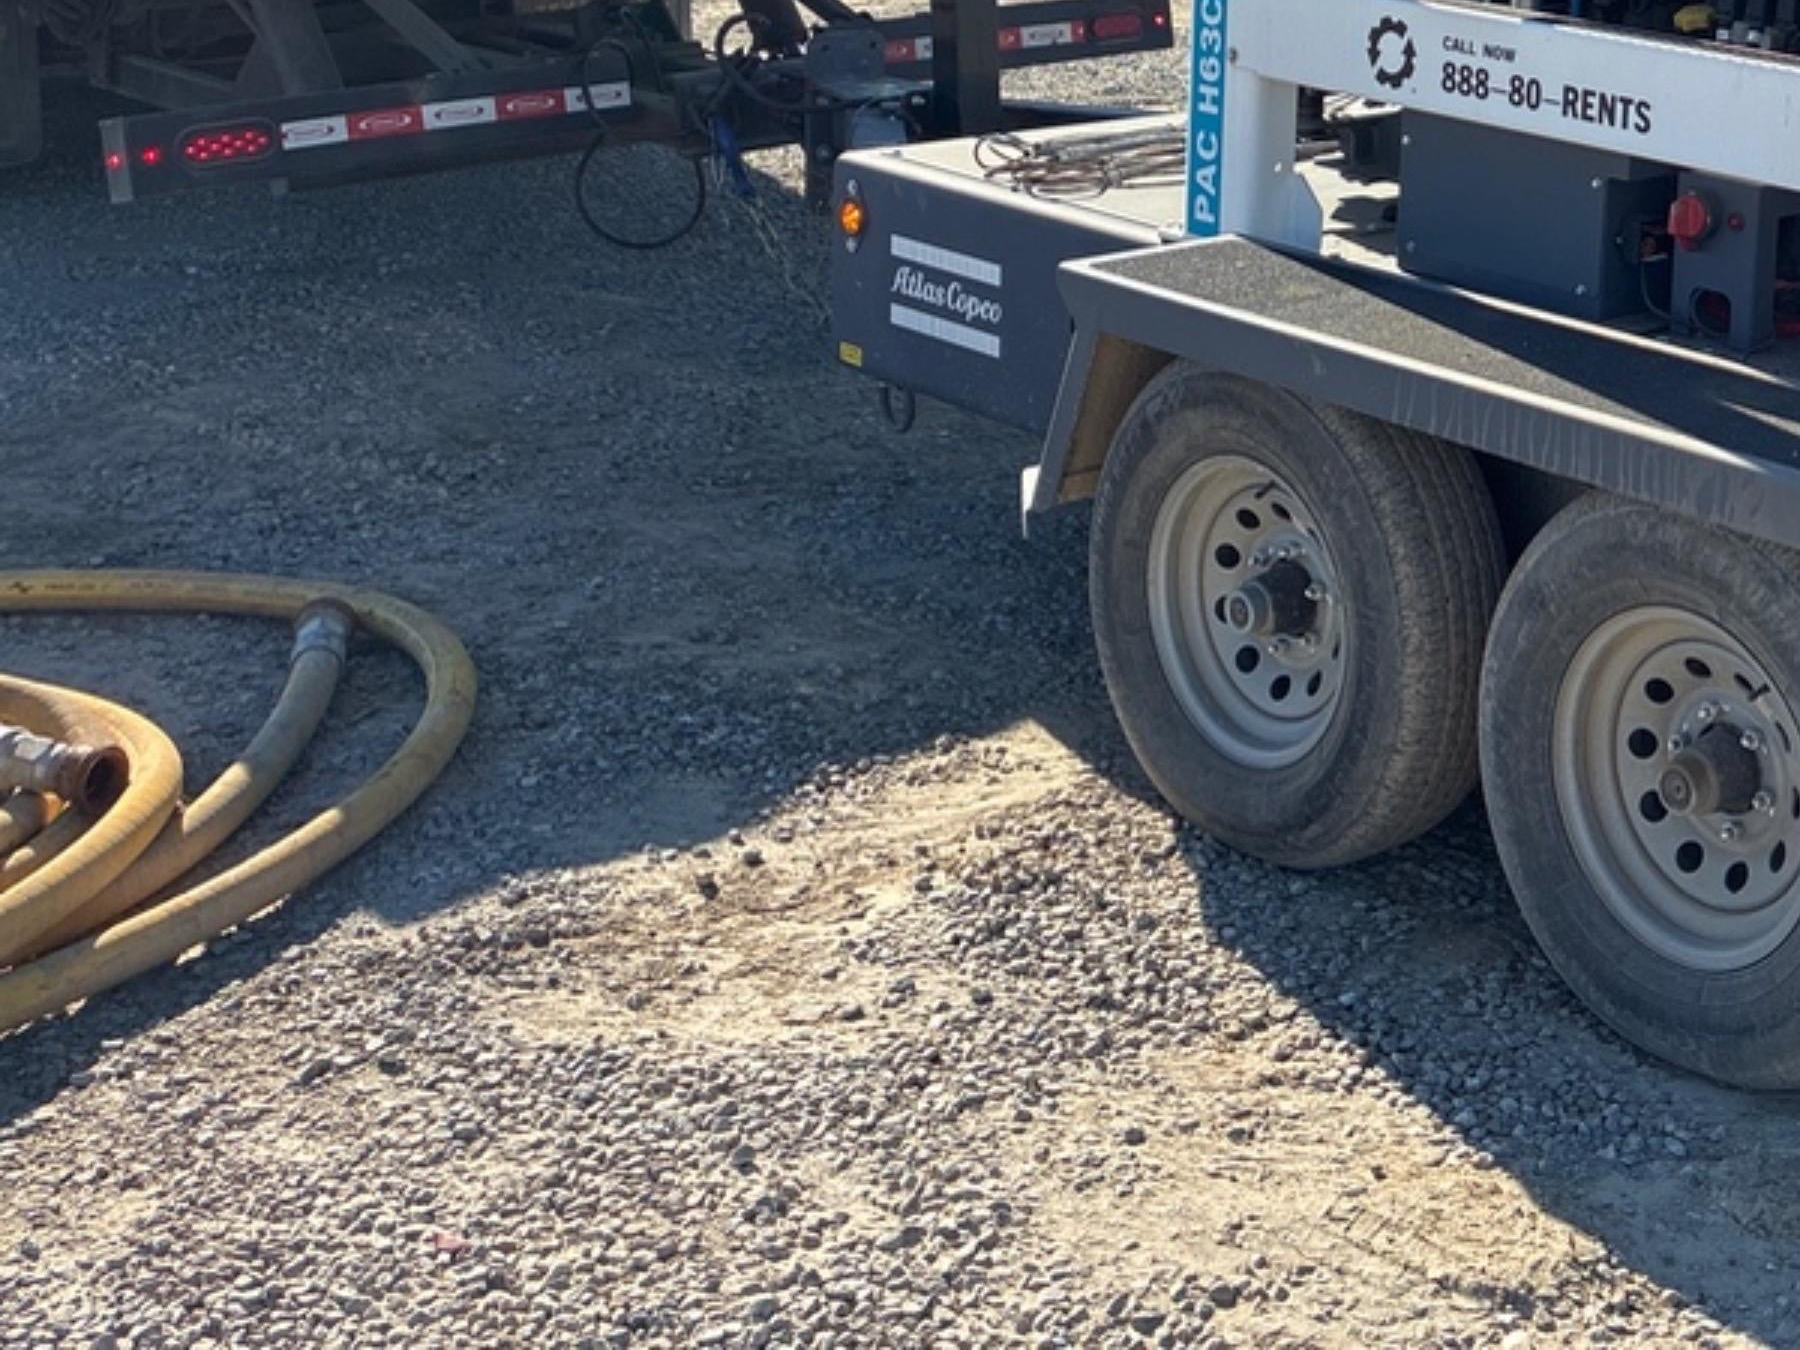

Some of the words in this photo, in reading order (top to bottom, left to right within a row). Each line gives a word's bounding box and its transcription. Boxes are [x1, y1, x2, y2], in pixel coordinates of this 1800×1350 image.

[1442, 35, 1476, 56] CALL
[1482, 44, 1516, 62] NOW
[1441, 61, 1651, 134] 888-80-RENTS
[1193, 130, 1219, 224] PAC
[890, 266, 946, 306] Atlas
[946, 281, 1002, 324] Copco
